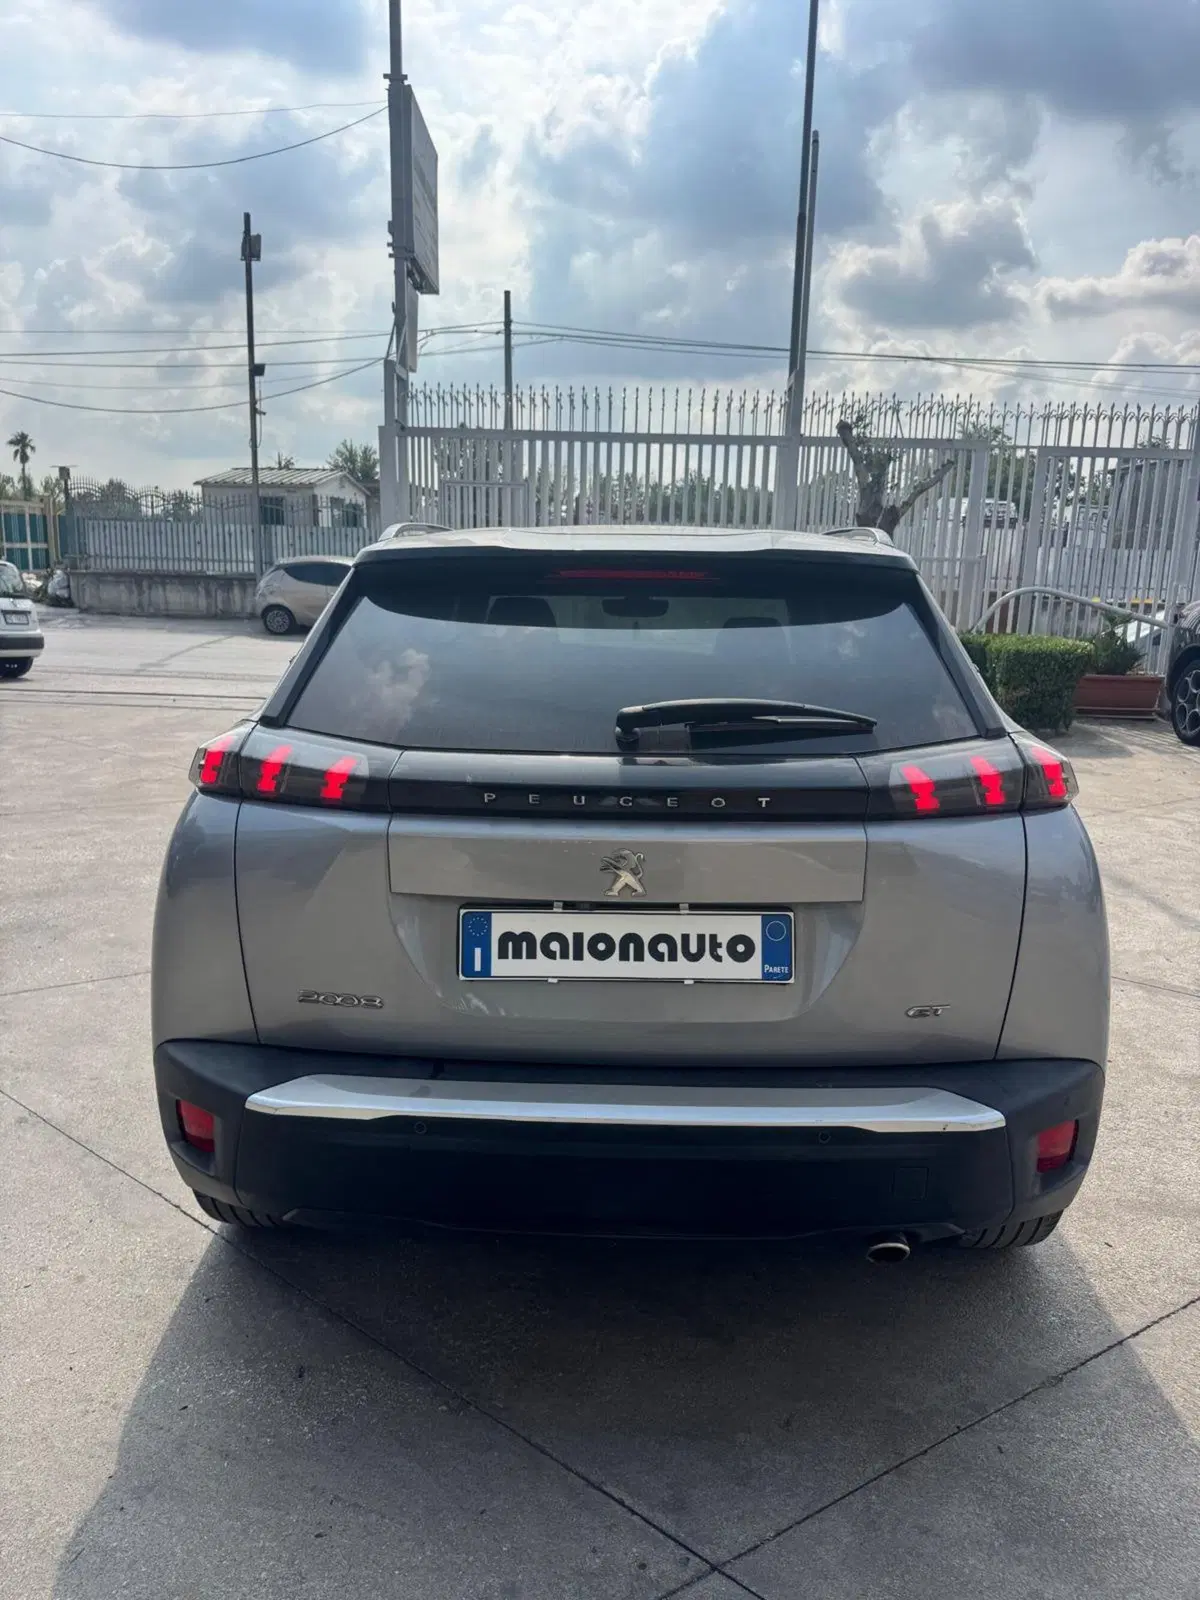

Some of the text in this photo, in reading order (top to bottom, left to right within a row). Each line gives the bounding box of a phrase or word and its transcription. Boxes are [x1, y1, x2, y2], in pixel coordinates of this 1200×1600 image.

[483, 792, 771, 808] PEUGEOT
[298, 989, 384, 1009] 2008
[906, 1004, 951, 1018] GT
